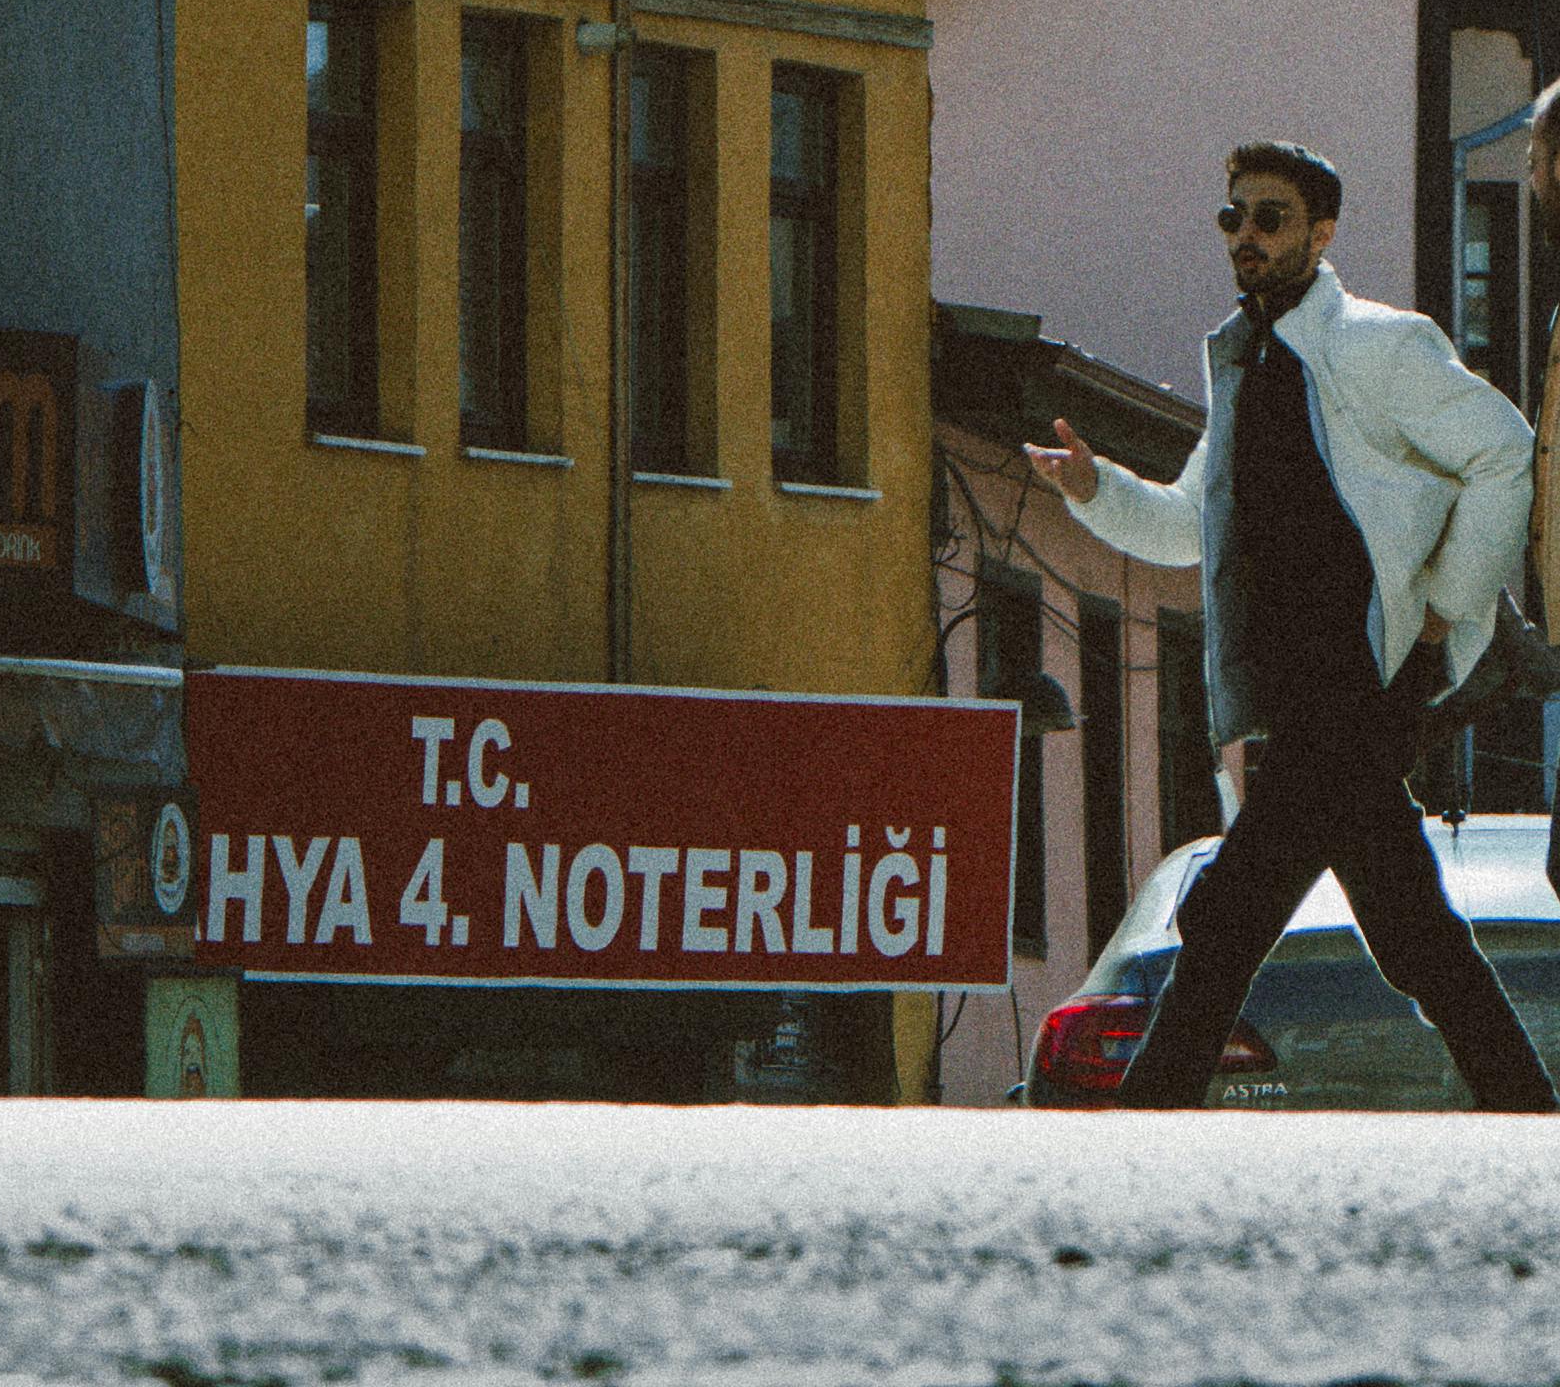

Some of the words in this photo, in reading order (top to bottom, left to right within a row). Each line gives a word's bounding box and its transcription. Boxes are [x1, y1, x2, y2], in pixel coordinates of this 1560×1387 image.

[411, 715, 530, 810] T.C.
[195, 833, 373, 946] HYA
[399, 837, 470, 947] 4.
[503, 824, 949, 958] NOTERLİĞİ
[1223, 1082, 1288, 1099] ASTRA
